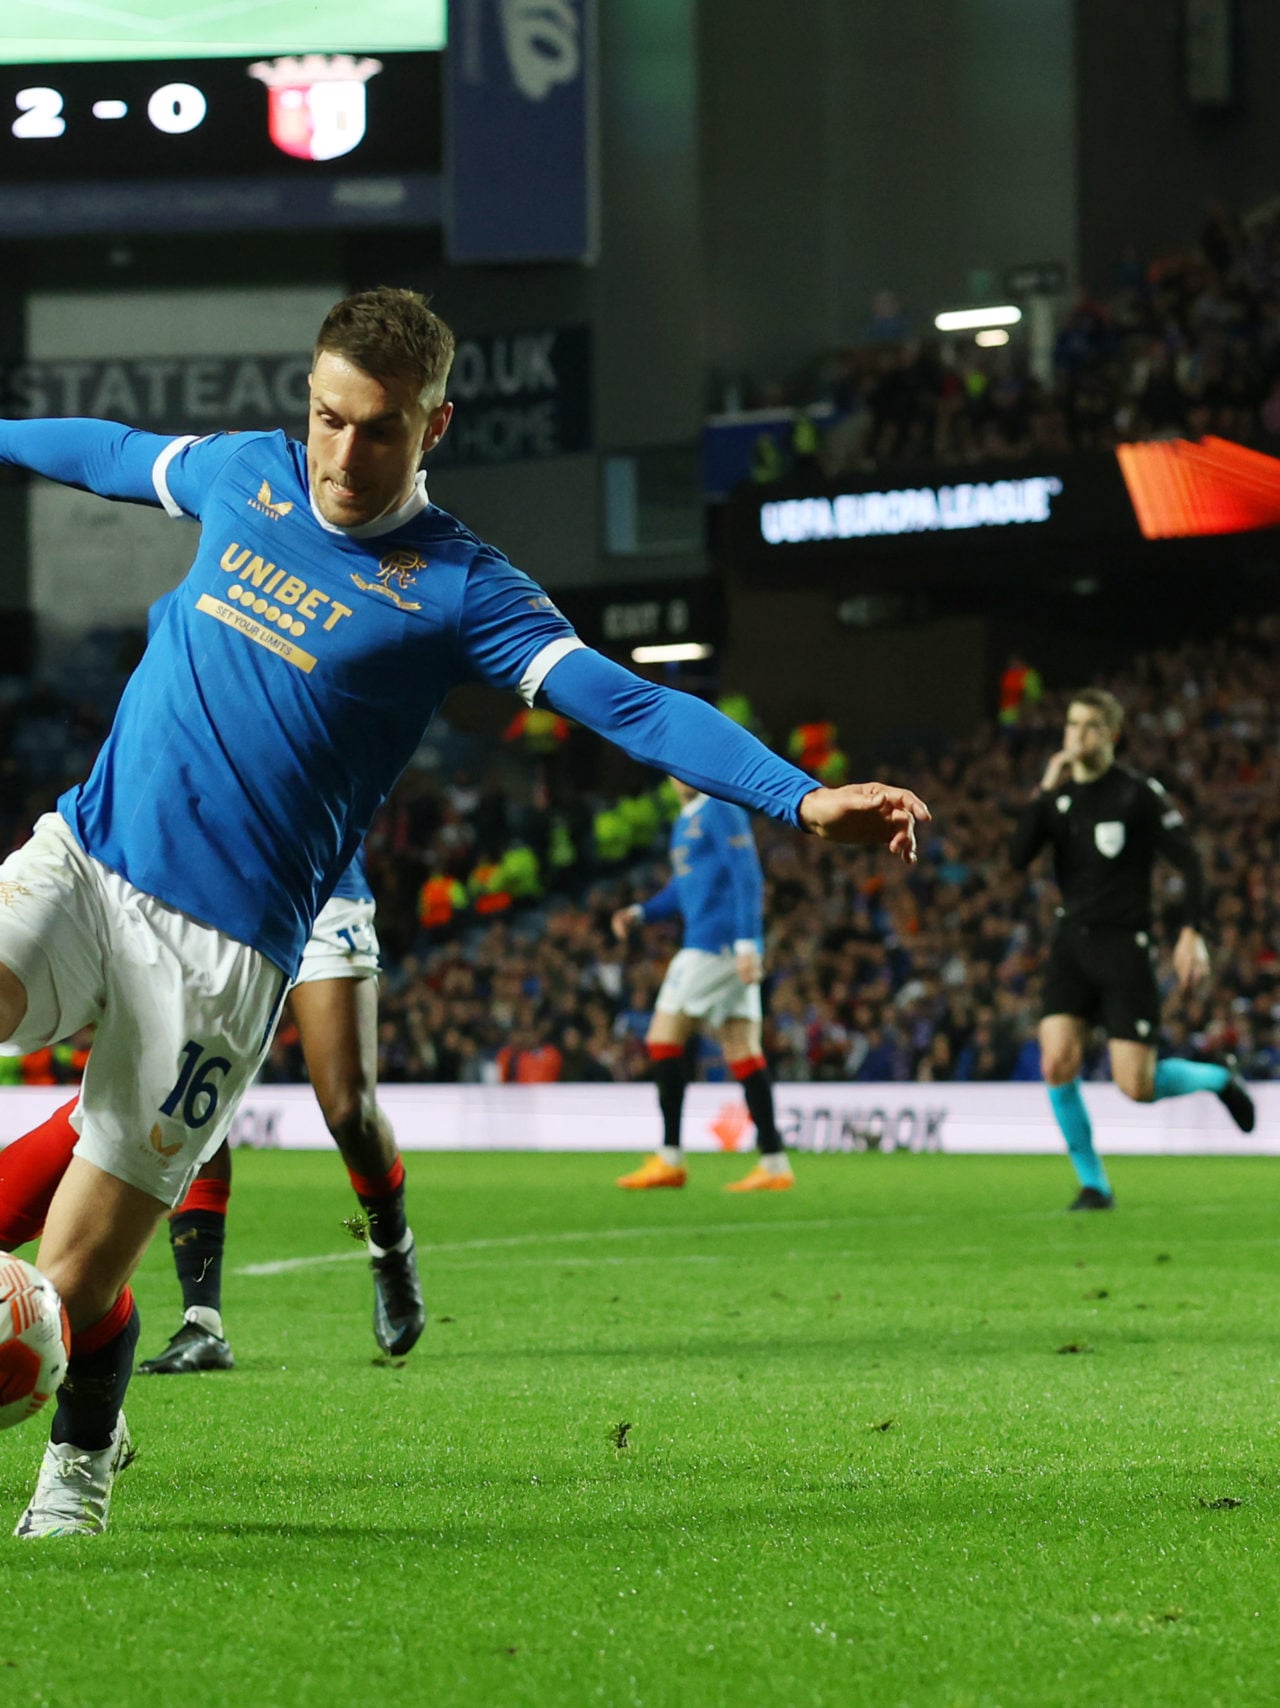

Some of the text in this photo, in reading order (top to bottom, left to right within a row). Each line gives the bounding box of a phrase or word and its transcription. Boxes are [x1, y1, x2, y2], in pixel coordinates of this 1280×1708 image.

[12, 86, 66, 139] 2
[147, 82, 207, 134] 0
[761, 497, 833, 544] UEFA
[220, 542, 353, 632] UNIBET
[215, 605, 294, 657] SET YOUR LIMITS
[159, 1040, 232, 1129] 16
